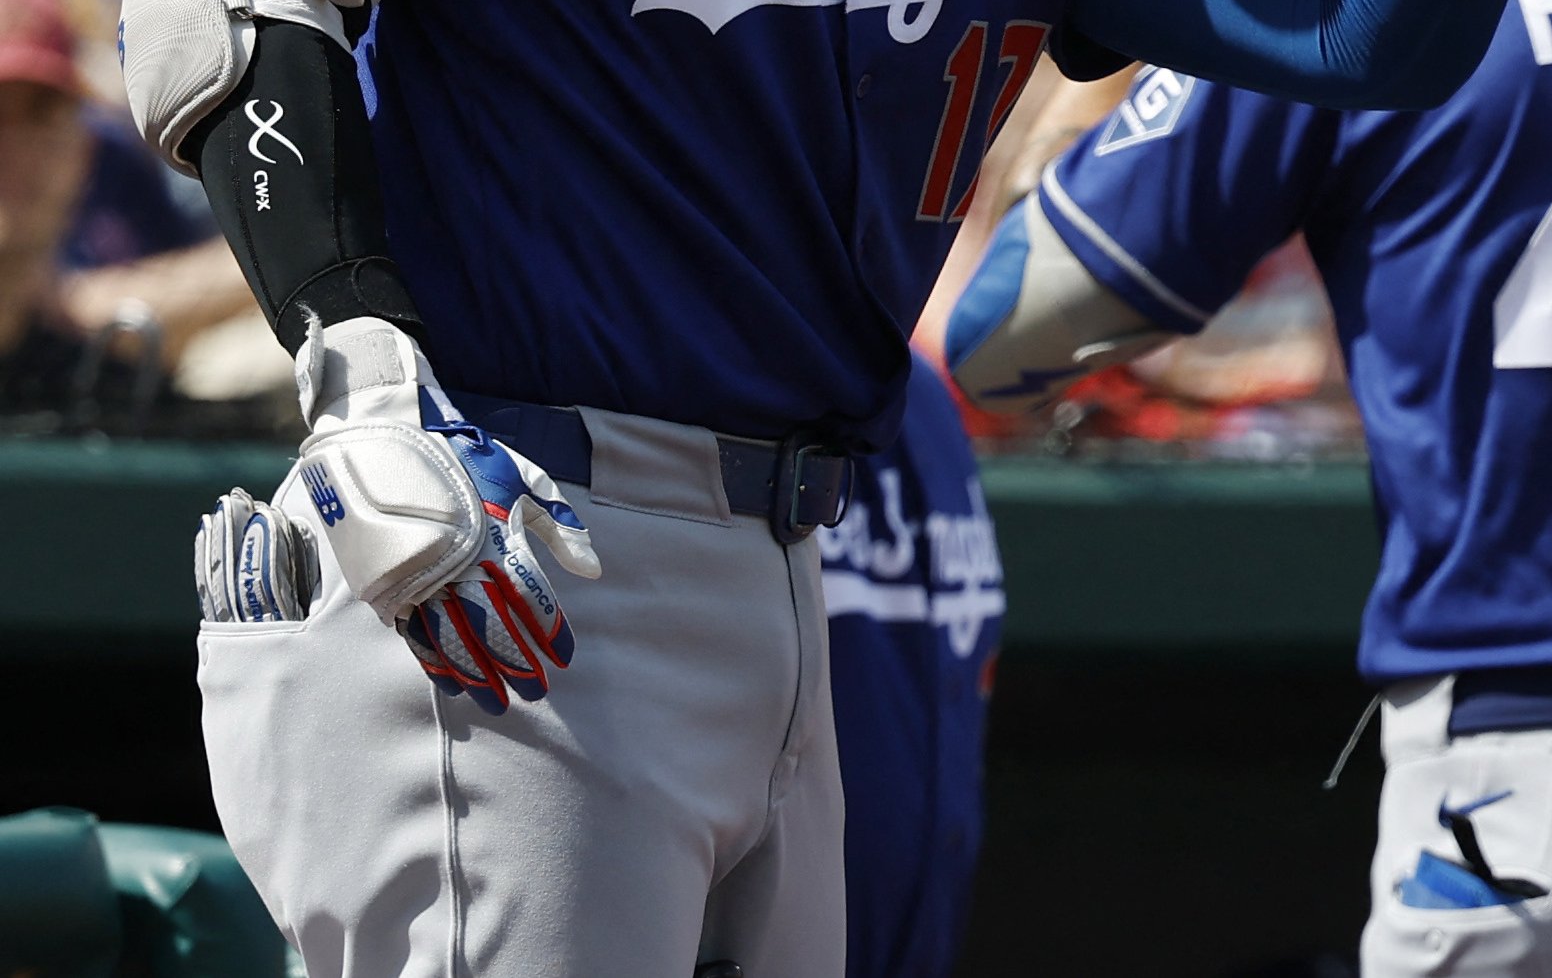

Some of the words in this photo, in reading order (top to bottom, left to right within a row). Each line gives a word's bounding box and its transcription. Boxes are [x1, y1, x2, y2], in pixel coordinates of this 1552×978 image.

[915, 19, 1052, 225] 17
[253, 170, 271, 212] CW-X
[489, 524, 511, 556] new
[507, 553, 555, 616] balance
